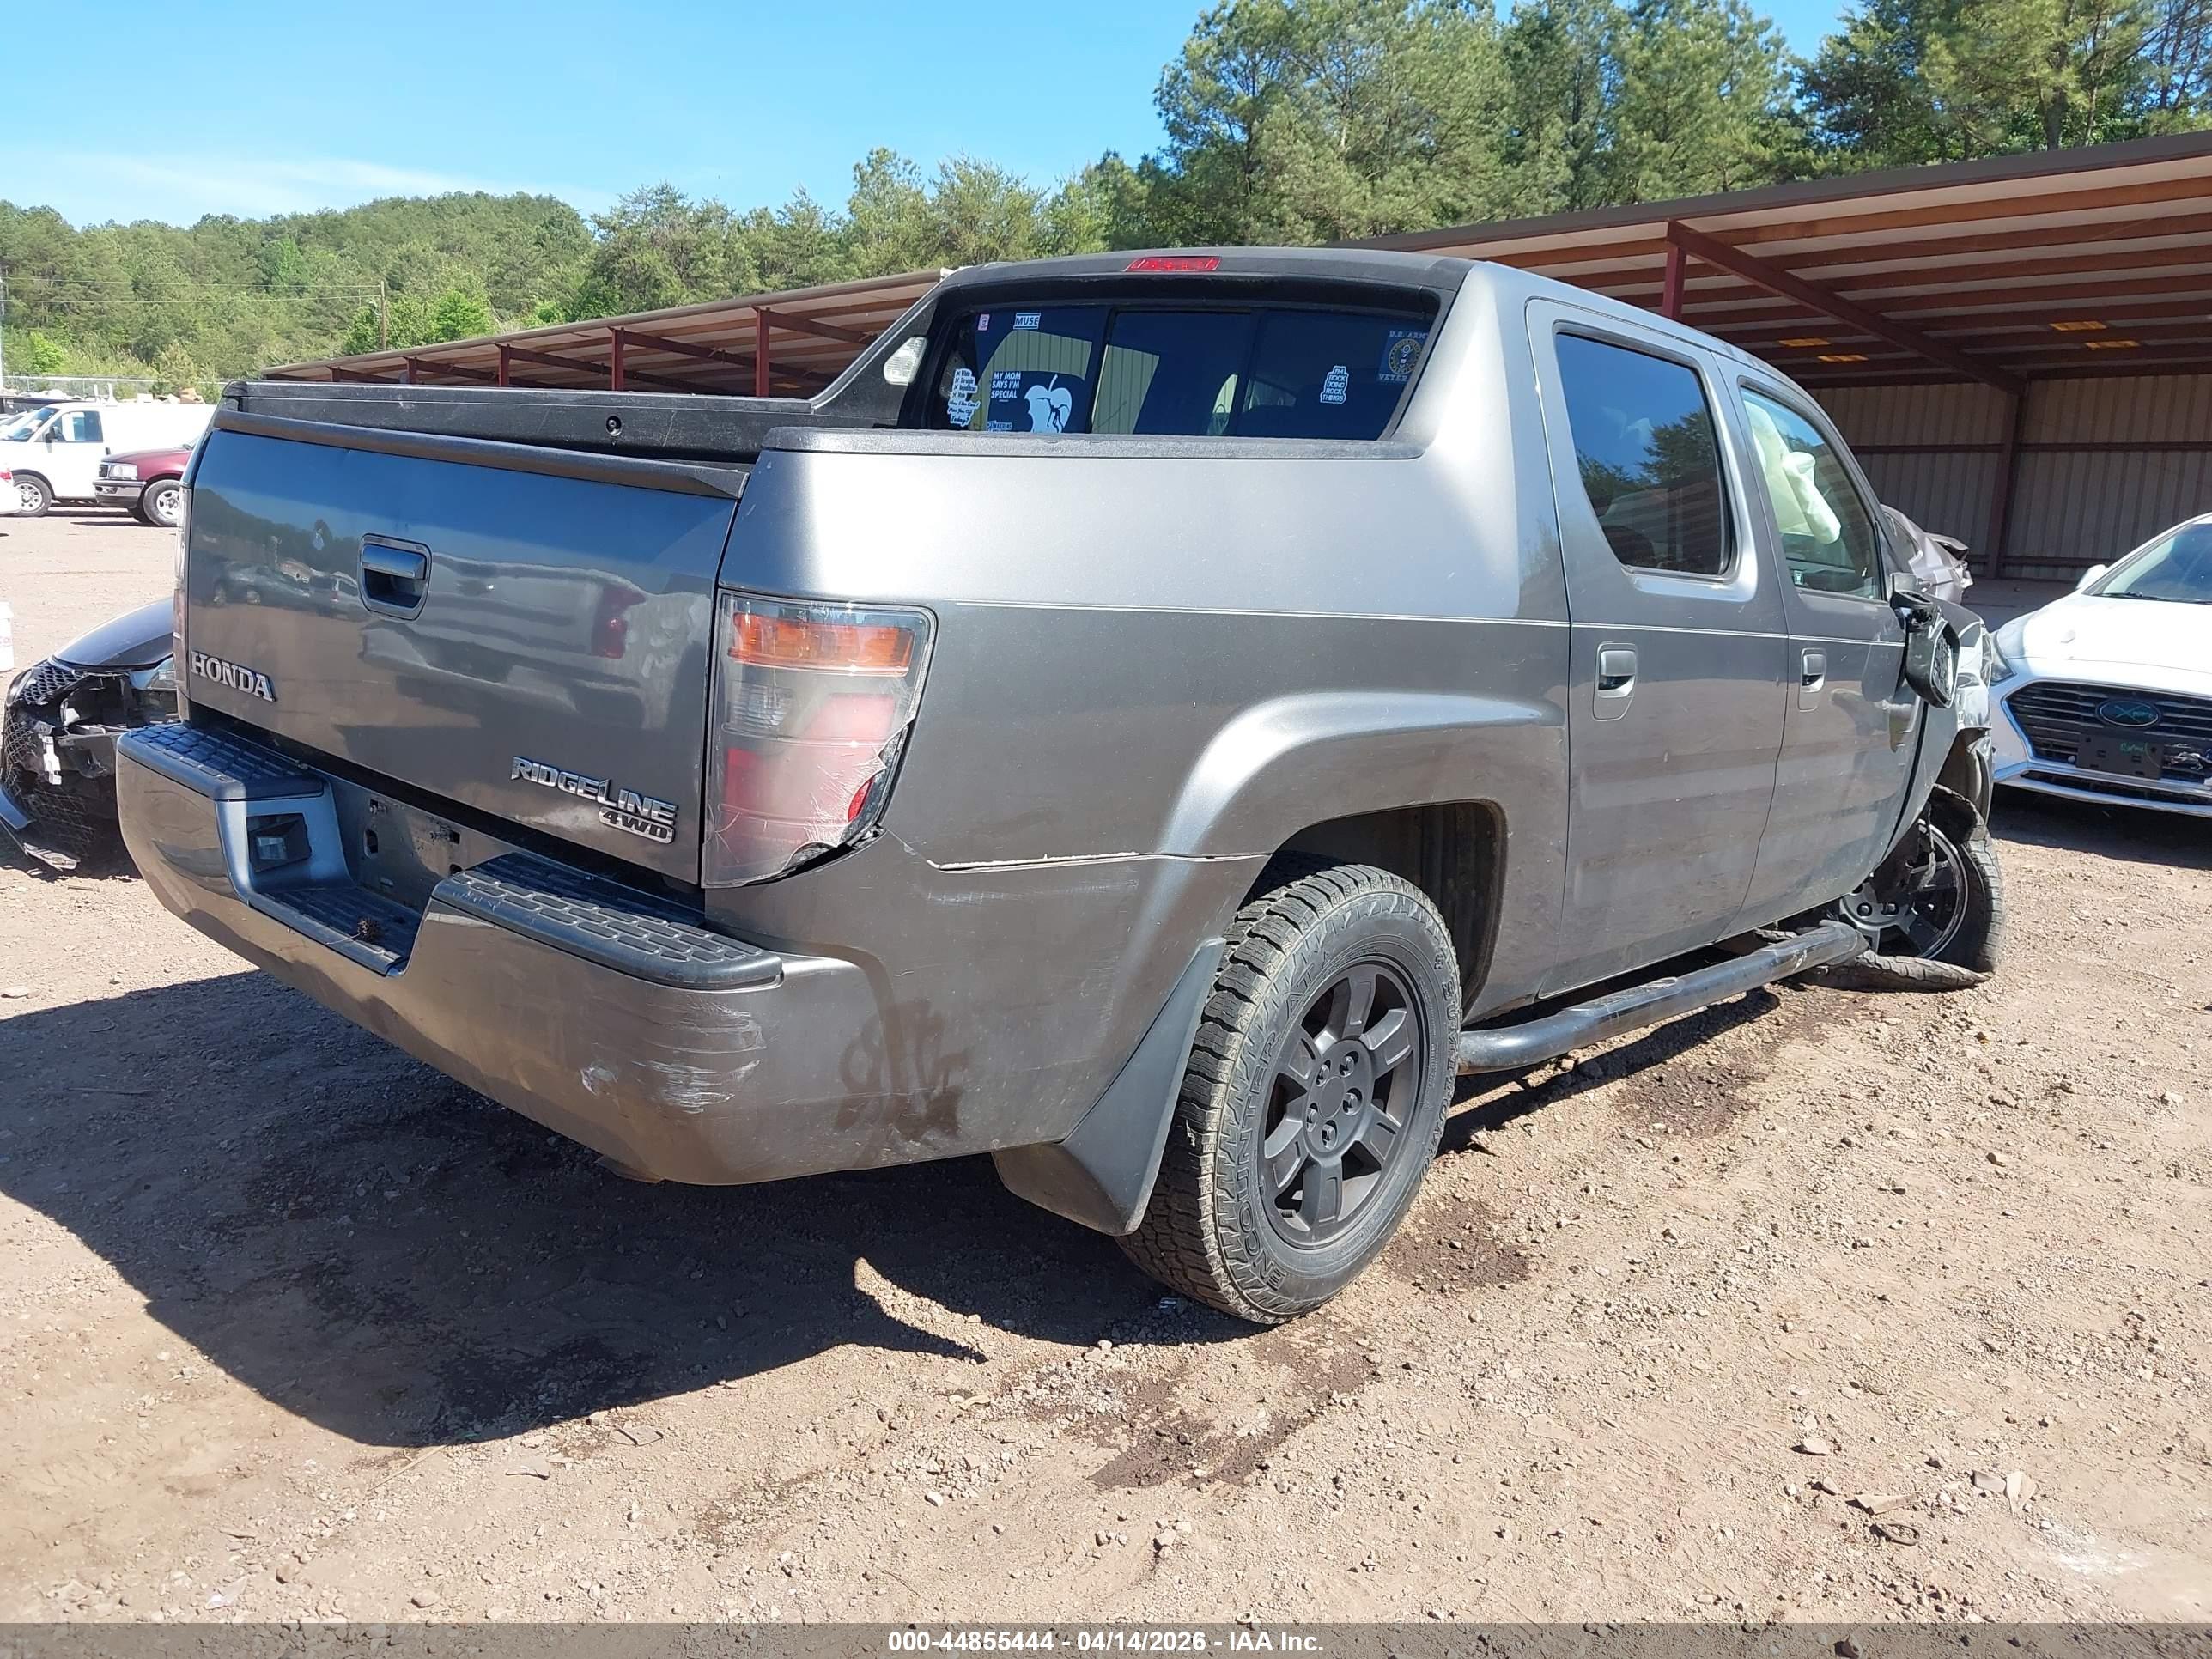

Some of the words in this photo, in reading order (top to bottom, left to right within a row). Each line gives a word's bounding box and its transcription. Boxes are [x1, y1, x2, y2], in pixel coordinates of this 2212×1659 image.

[1015, 317, 1039, 325] MUSE
[990, 389, 1018, 399] SPECIAL
[991, 380, 1008, 389] SAYS
[1008, 380, 1020, 389] I'M
[191, 650, 276, 702] HONDA
[511, 756, 678, 825] RIDGELINE
[602, 810, 669, 839] 4WD
[1236, 1030, 1288, 1292] ENCOUNTER
